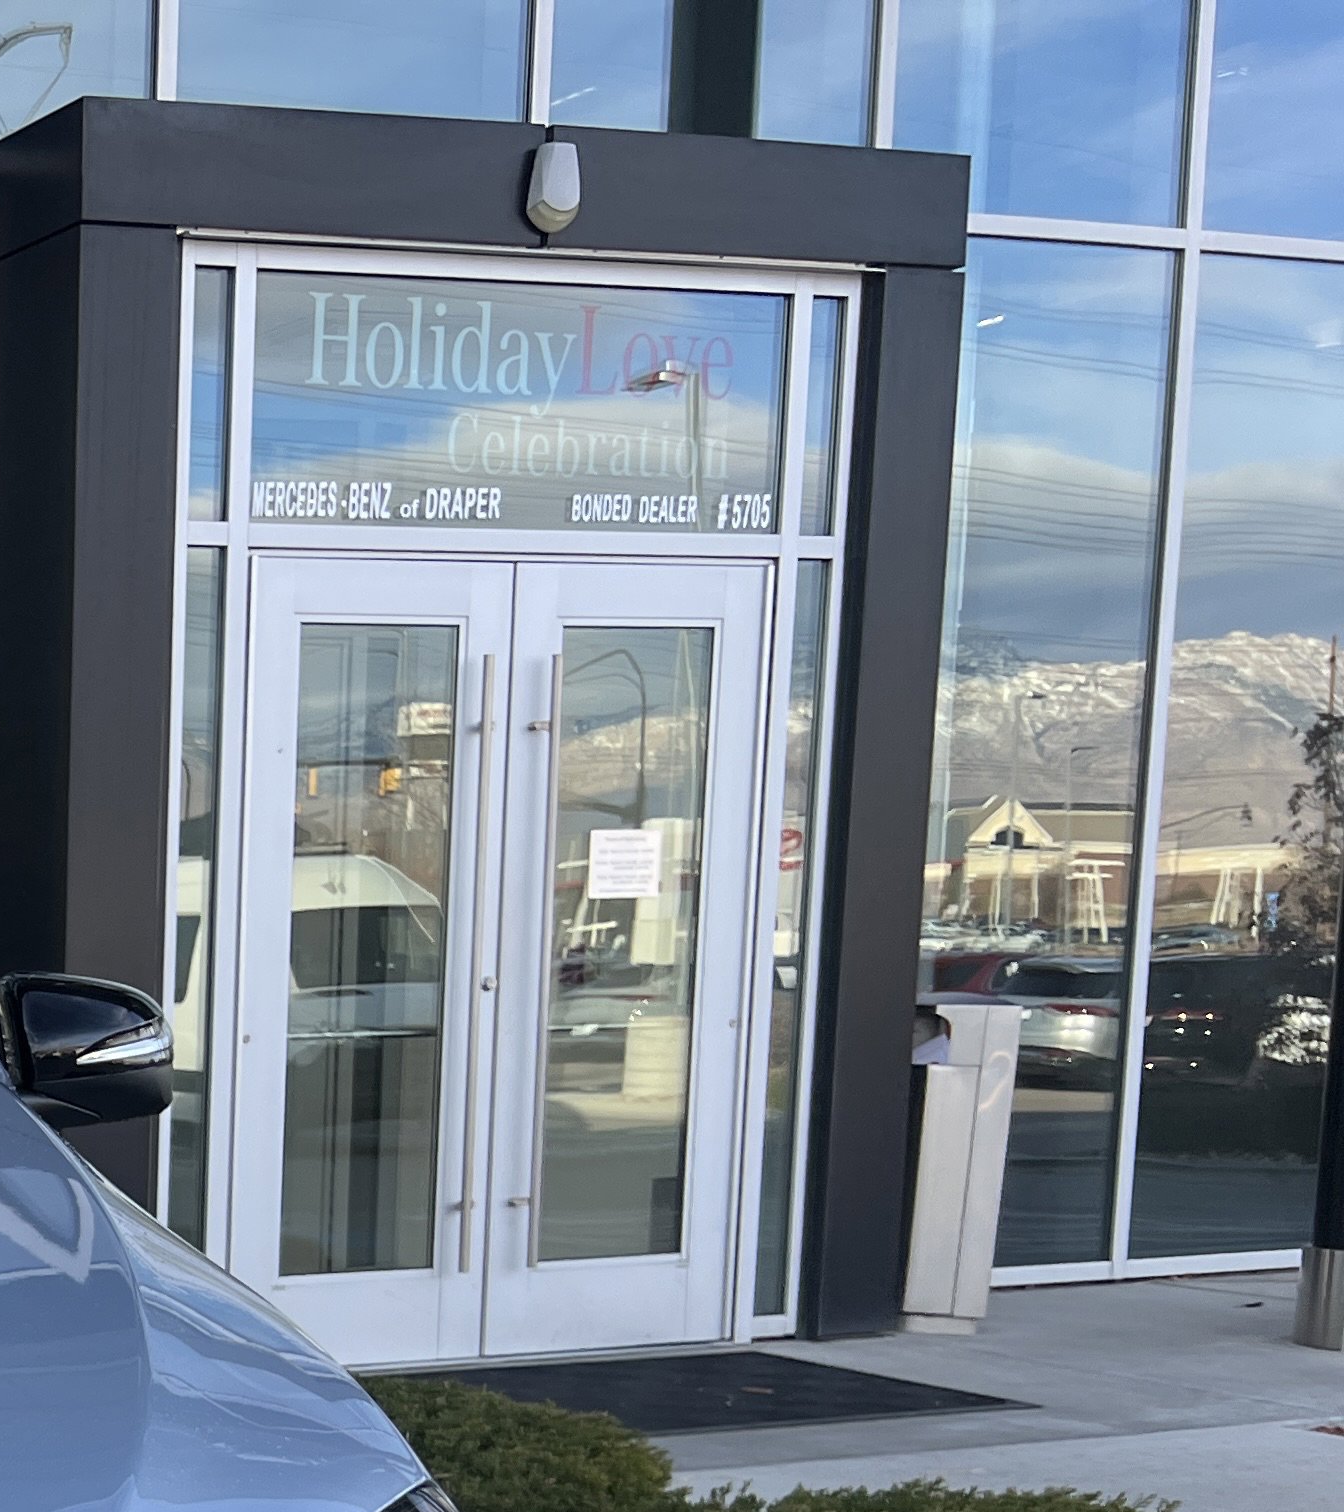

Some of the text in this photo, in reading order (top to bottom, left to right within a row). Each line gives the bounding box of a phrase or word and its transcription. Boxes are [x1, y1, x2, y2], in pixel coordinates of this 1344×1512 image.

[447, 412, 730, 480] Celebration
[400, 499, 419, 519] of
[425, 487, 502, 519] DRAPER
[571, 494, 632, 522] BONDED
[638, 495, 698, 523] DEALER
